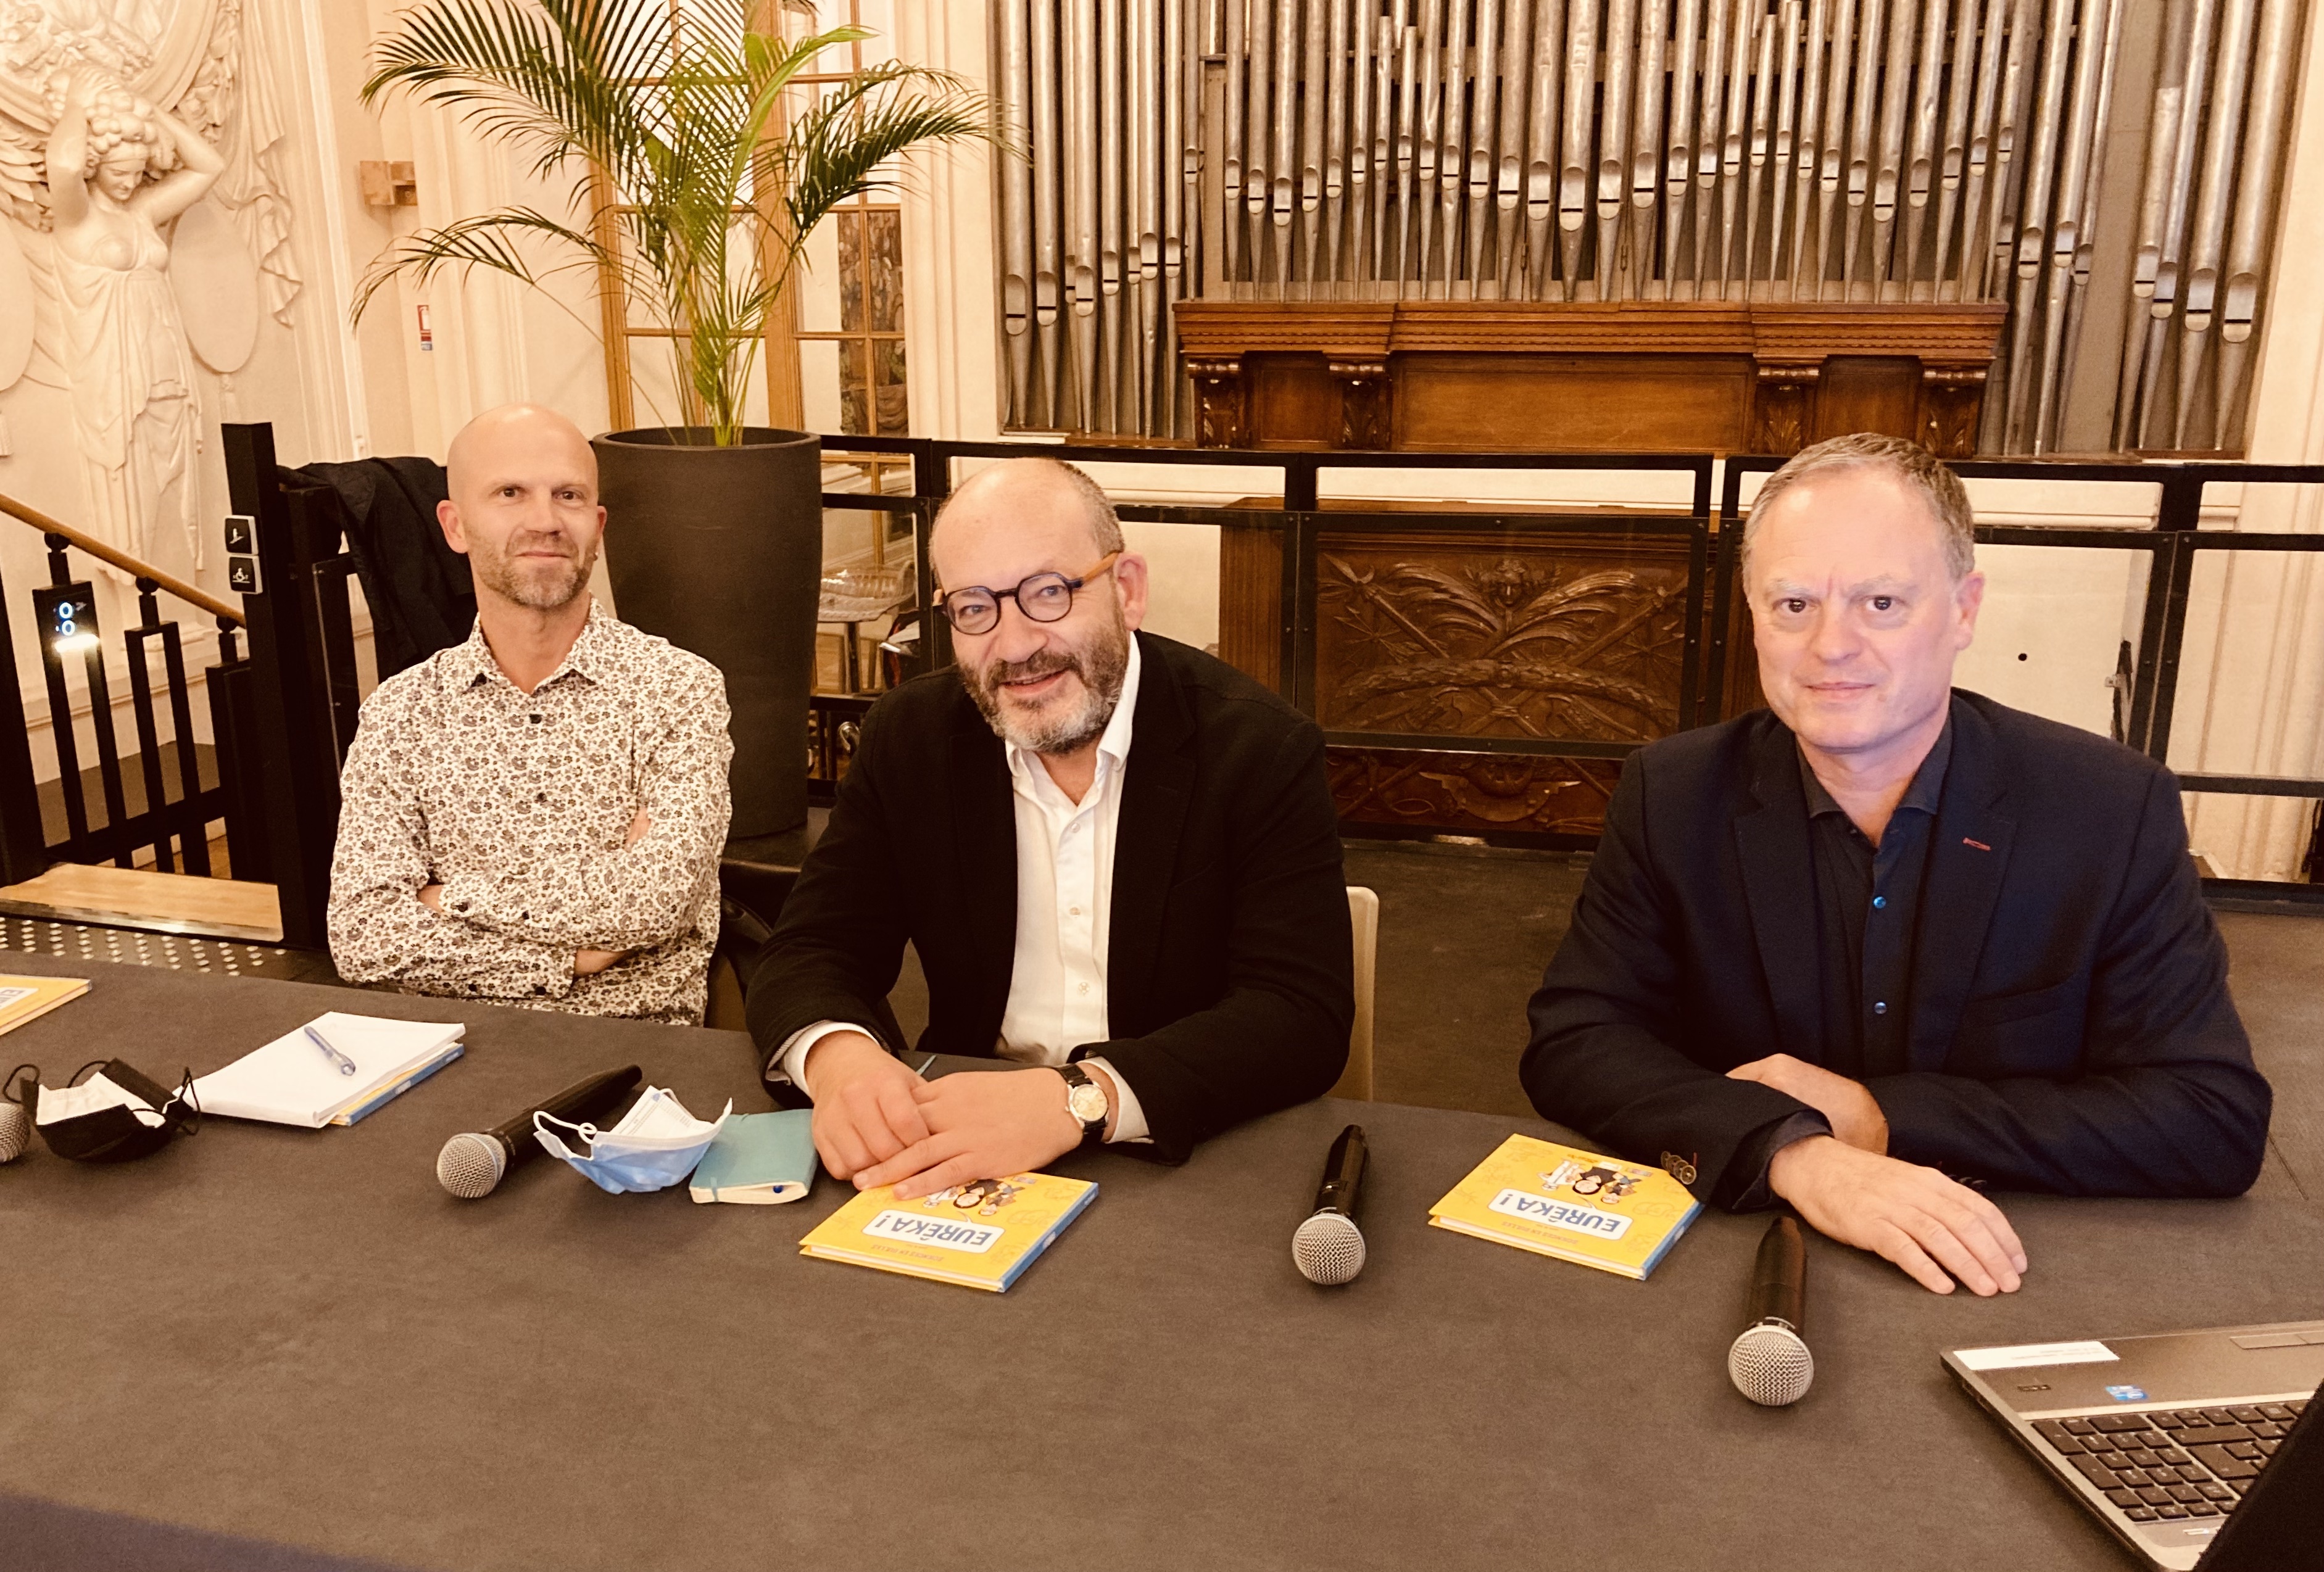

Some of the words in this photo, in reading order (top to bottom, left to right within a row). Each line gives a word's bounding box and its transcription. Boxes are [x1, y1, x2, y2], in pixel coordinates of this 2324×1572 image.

[1498, 1193, 1514, 1206] !
[874, 1215, 891, 1228] !
[1516, 1197, 1621, 1233] EURÊKA
[890, 1217, 992, 1246] EURÊKA
